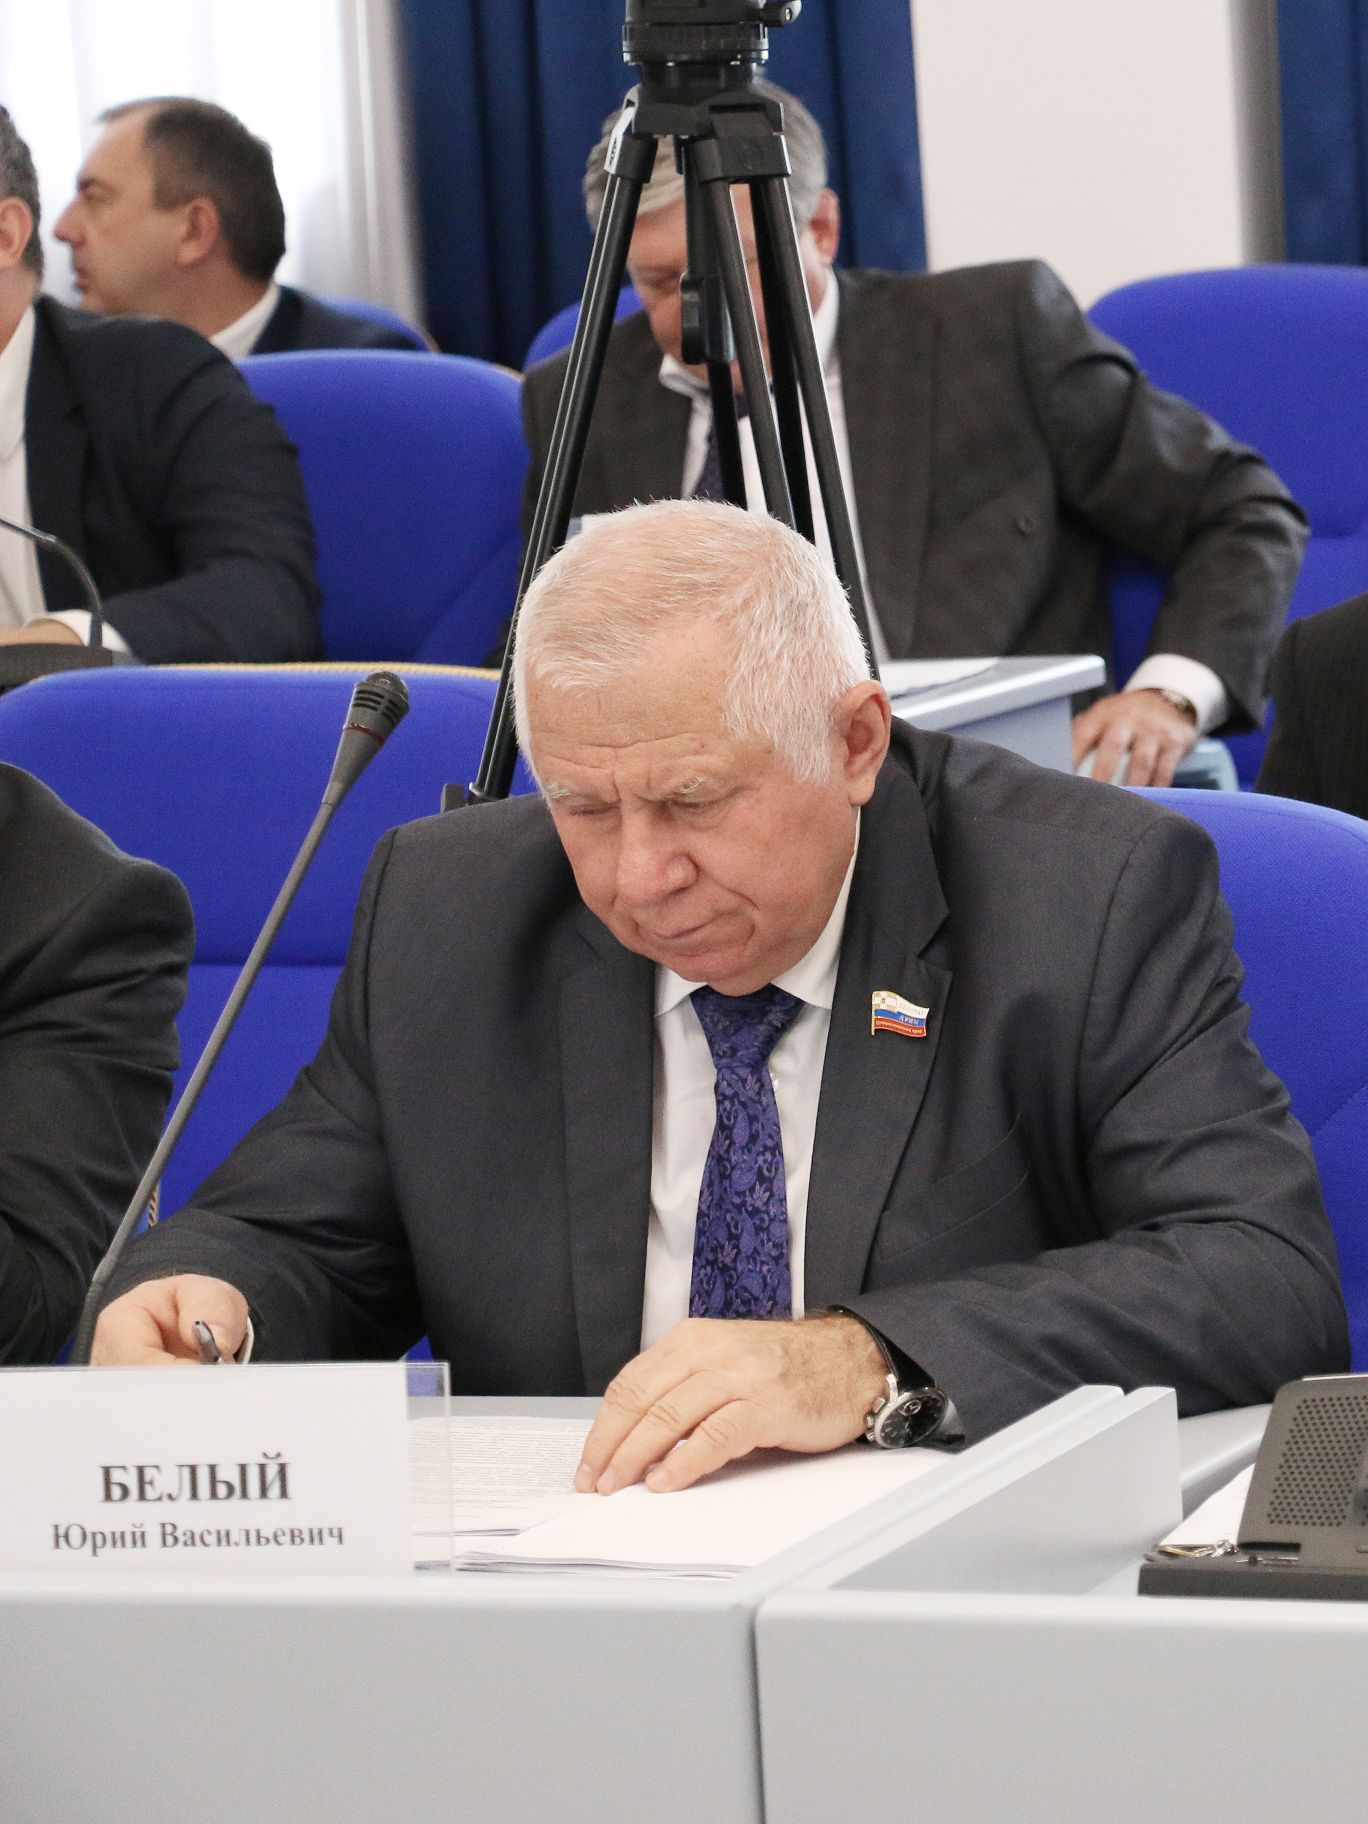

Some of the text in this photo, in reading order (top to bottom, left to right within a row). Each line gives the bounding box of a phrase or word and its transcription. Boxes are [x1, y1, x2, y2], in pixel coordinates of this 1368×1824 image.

[98, 1451, 292, 1504] БЕЛЫЙ
[52, 1521, 345, 1558] Юрий Васильевич
